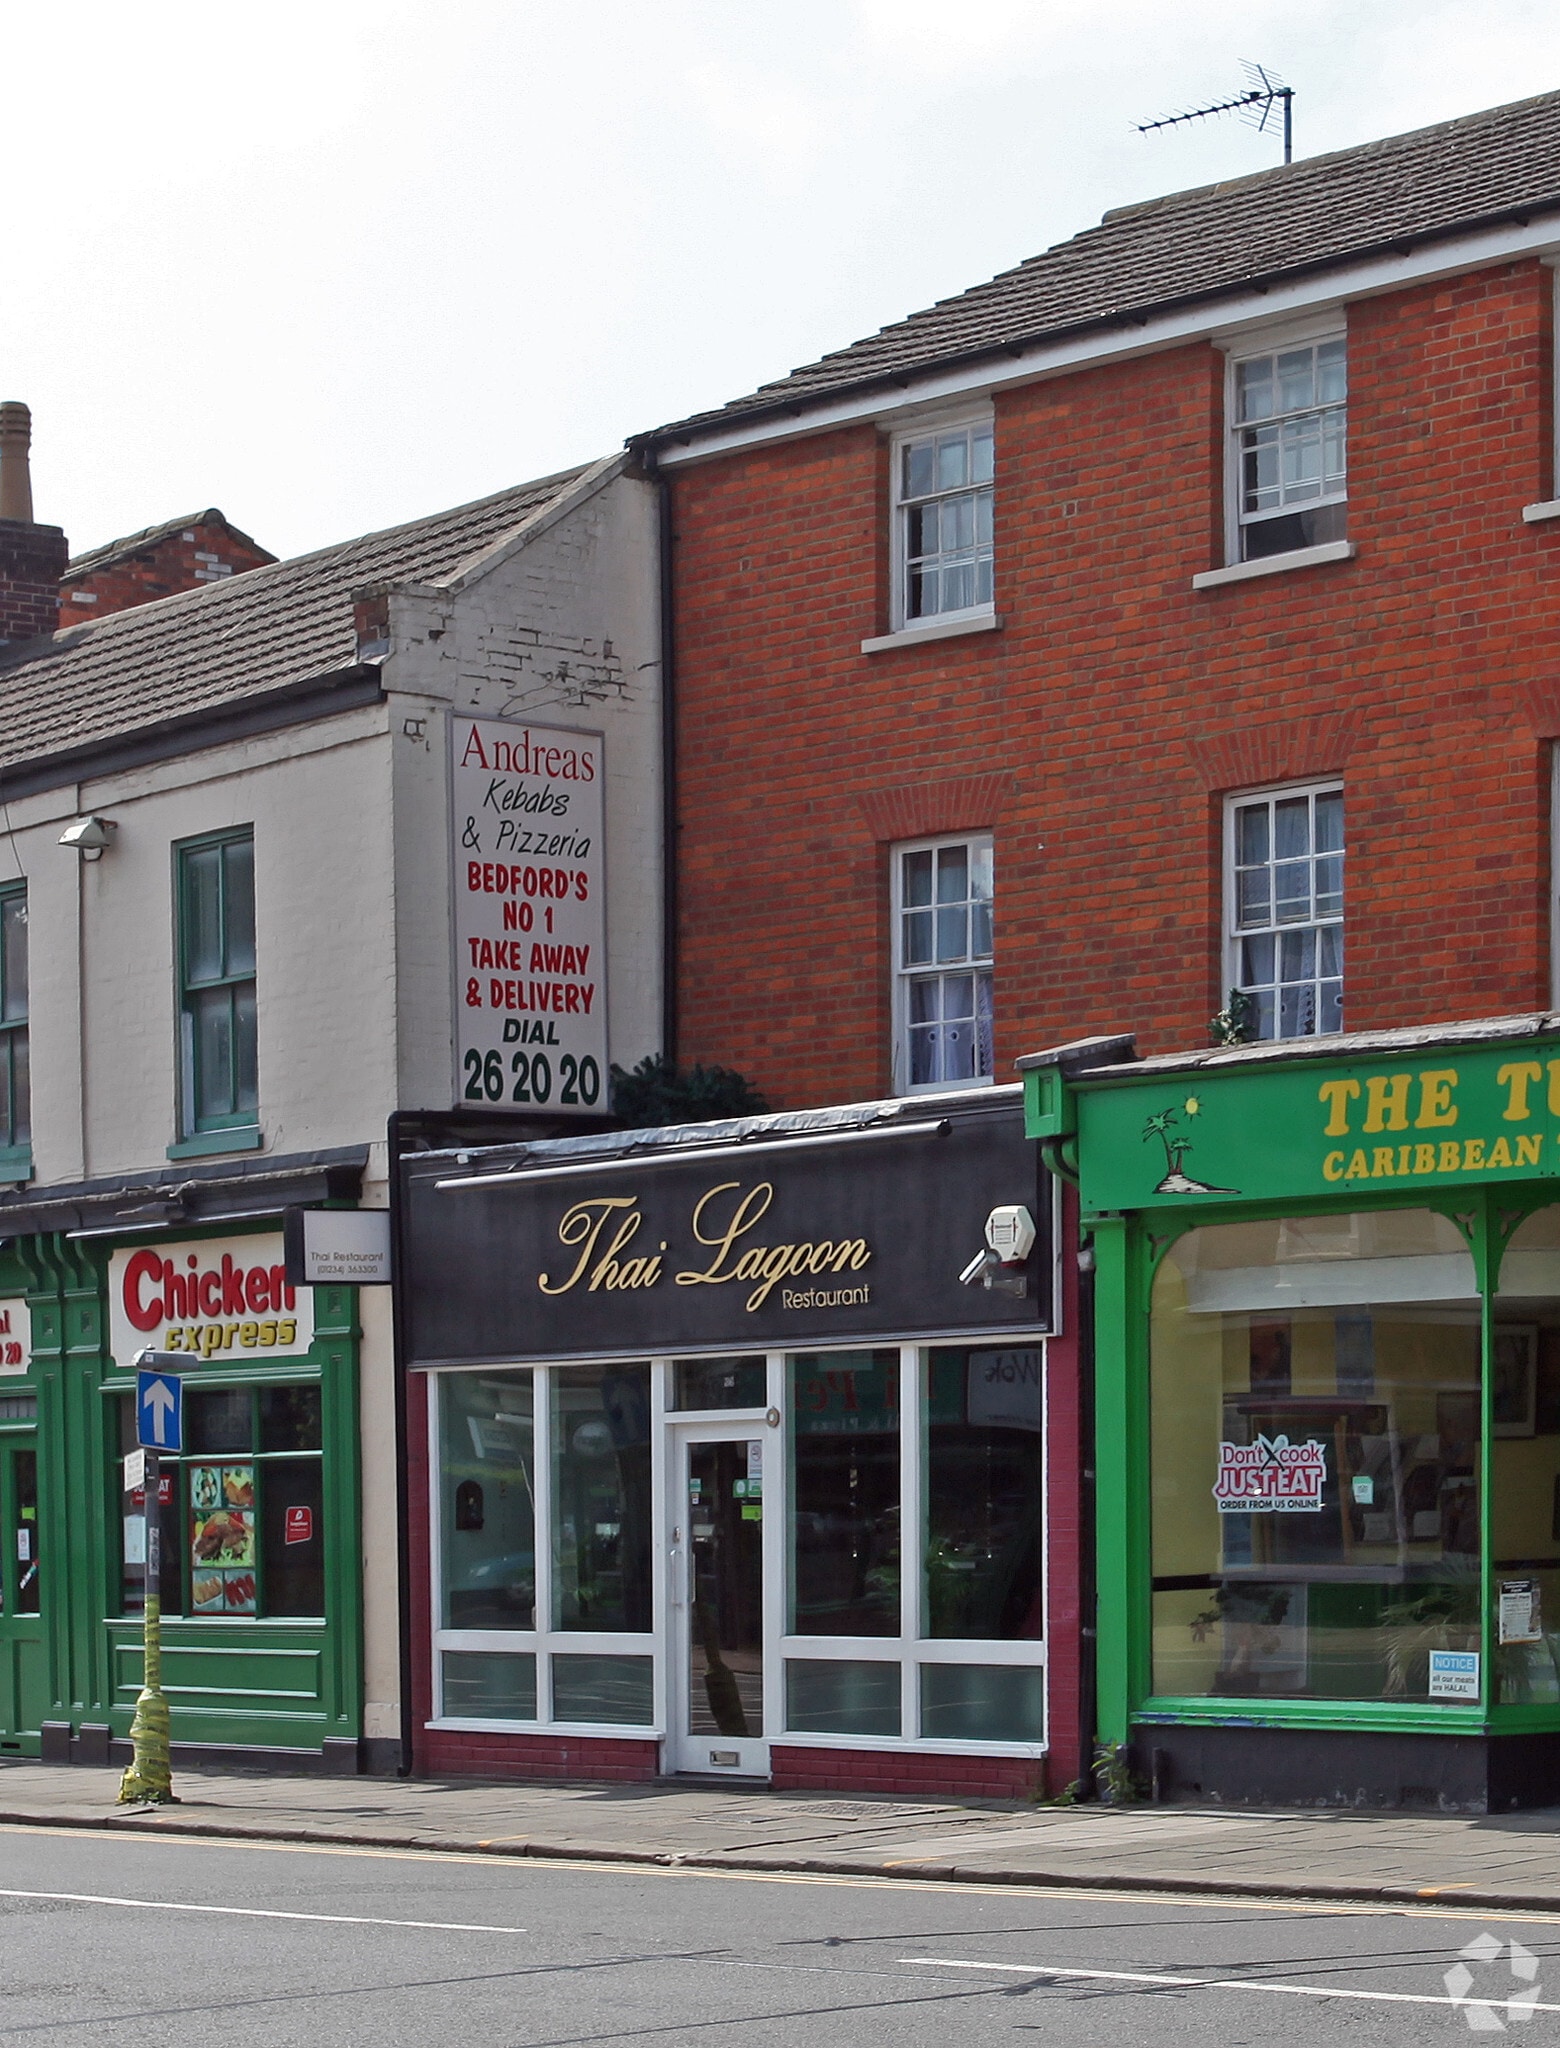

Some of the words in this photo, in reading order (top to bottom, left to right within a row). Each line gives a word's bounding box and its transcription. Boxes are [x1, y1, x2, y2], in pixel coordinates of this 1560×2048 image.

[460, 723, 594, 782] Andreas
[483, 778, 570, 816] Kebabs
[462, 816, 481, 853] &
[496, 820, 591, 858] Pizzeria
[468, 861, 588, 901] BEDFORD'S
[503, 900, 533, 933] NO
[544, 905, 553, 934] 1
[468, 937, 522, 971] TAKE
[530, 942, 590, 976] AWAY
[466, 977, 482, 1008] &
[490, 978, 594, 1014] DELIVERY
[502, 1018, 560, 1045] DIAL
[464, 1048, 503, 1101] 26
[512, 1051, 552, 1104] 20
[560, 1053, 600, 1106] 20
[1318, 1068, 1459, 1136] THE
[1322, 1134, 1543, 1182] CARIBBEAN
[311, 1252, 330, 1261] Thai
[333, 1252, 383, 1261] Restaurant
[538, 1195, 668, 1295] Thai
[675, 1182, 871, 1312] Lagoon
[123, 1249, 296, 1331] Chicken
[783, 1285, 870, 1309] Restaurant
[1222, 1446, 1264, 1464] Don't
[1280, 1444, 1321, 1463] cook
[1217, 1469, 1274, 1496] JUST
[1277, 1468, 1322, 1494] EAT
[1221, 1500, 1247, 1509] ORDER
[1249, 1500, 1272, 1508] FROM
[1274, 1500, 1285, 1508] US
[1287, 1499, 1319, 1508] ONLINE
[1434, 1657, 1474, 1670] NOTICE
[1443, 1684, 1468, 1692] HALAL
